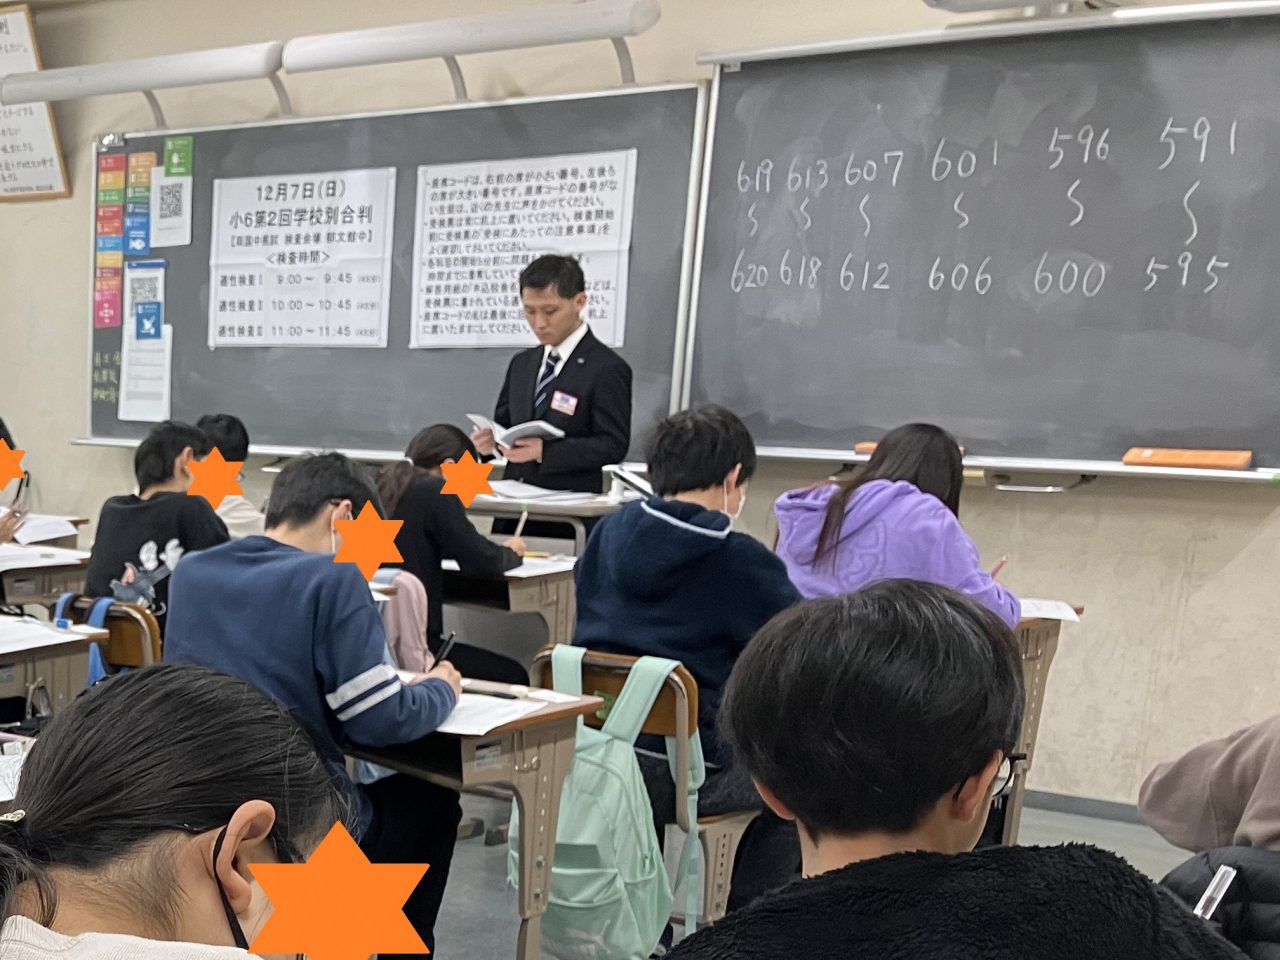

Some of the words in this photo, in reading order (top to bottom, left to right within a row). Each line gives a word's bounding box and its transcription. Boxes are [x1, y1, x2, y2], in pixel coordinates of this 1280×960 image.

[736, 159, 774, 194] 619
[787, 159, 829, 192] 613
[844, 149, 904, 187] 607
[931, 136, 1000, 182] 601
[1047, 123, 1110, 170] 596
[1157, 116, 1238, 170] 591
[256, 178, 347, 202] 12月7日(日)
[229, 204, 374, 229] 小6第2回学校別合判
[730, 248, 769, 294] 620
[778, 251, 822, 290] 618
[839, 252, 890, 291] 612
[928, 256, 992, 296] 606
[1034, 251, 1107, 297] 600
[1143, 251, 1230, 294] 595
